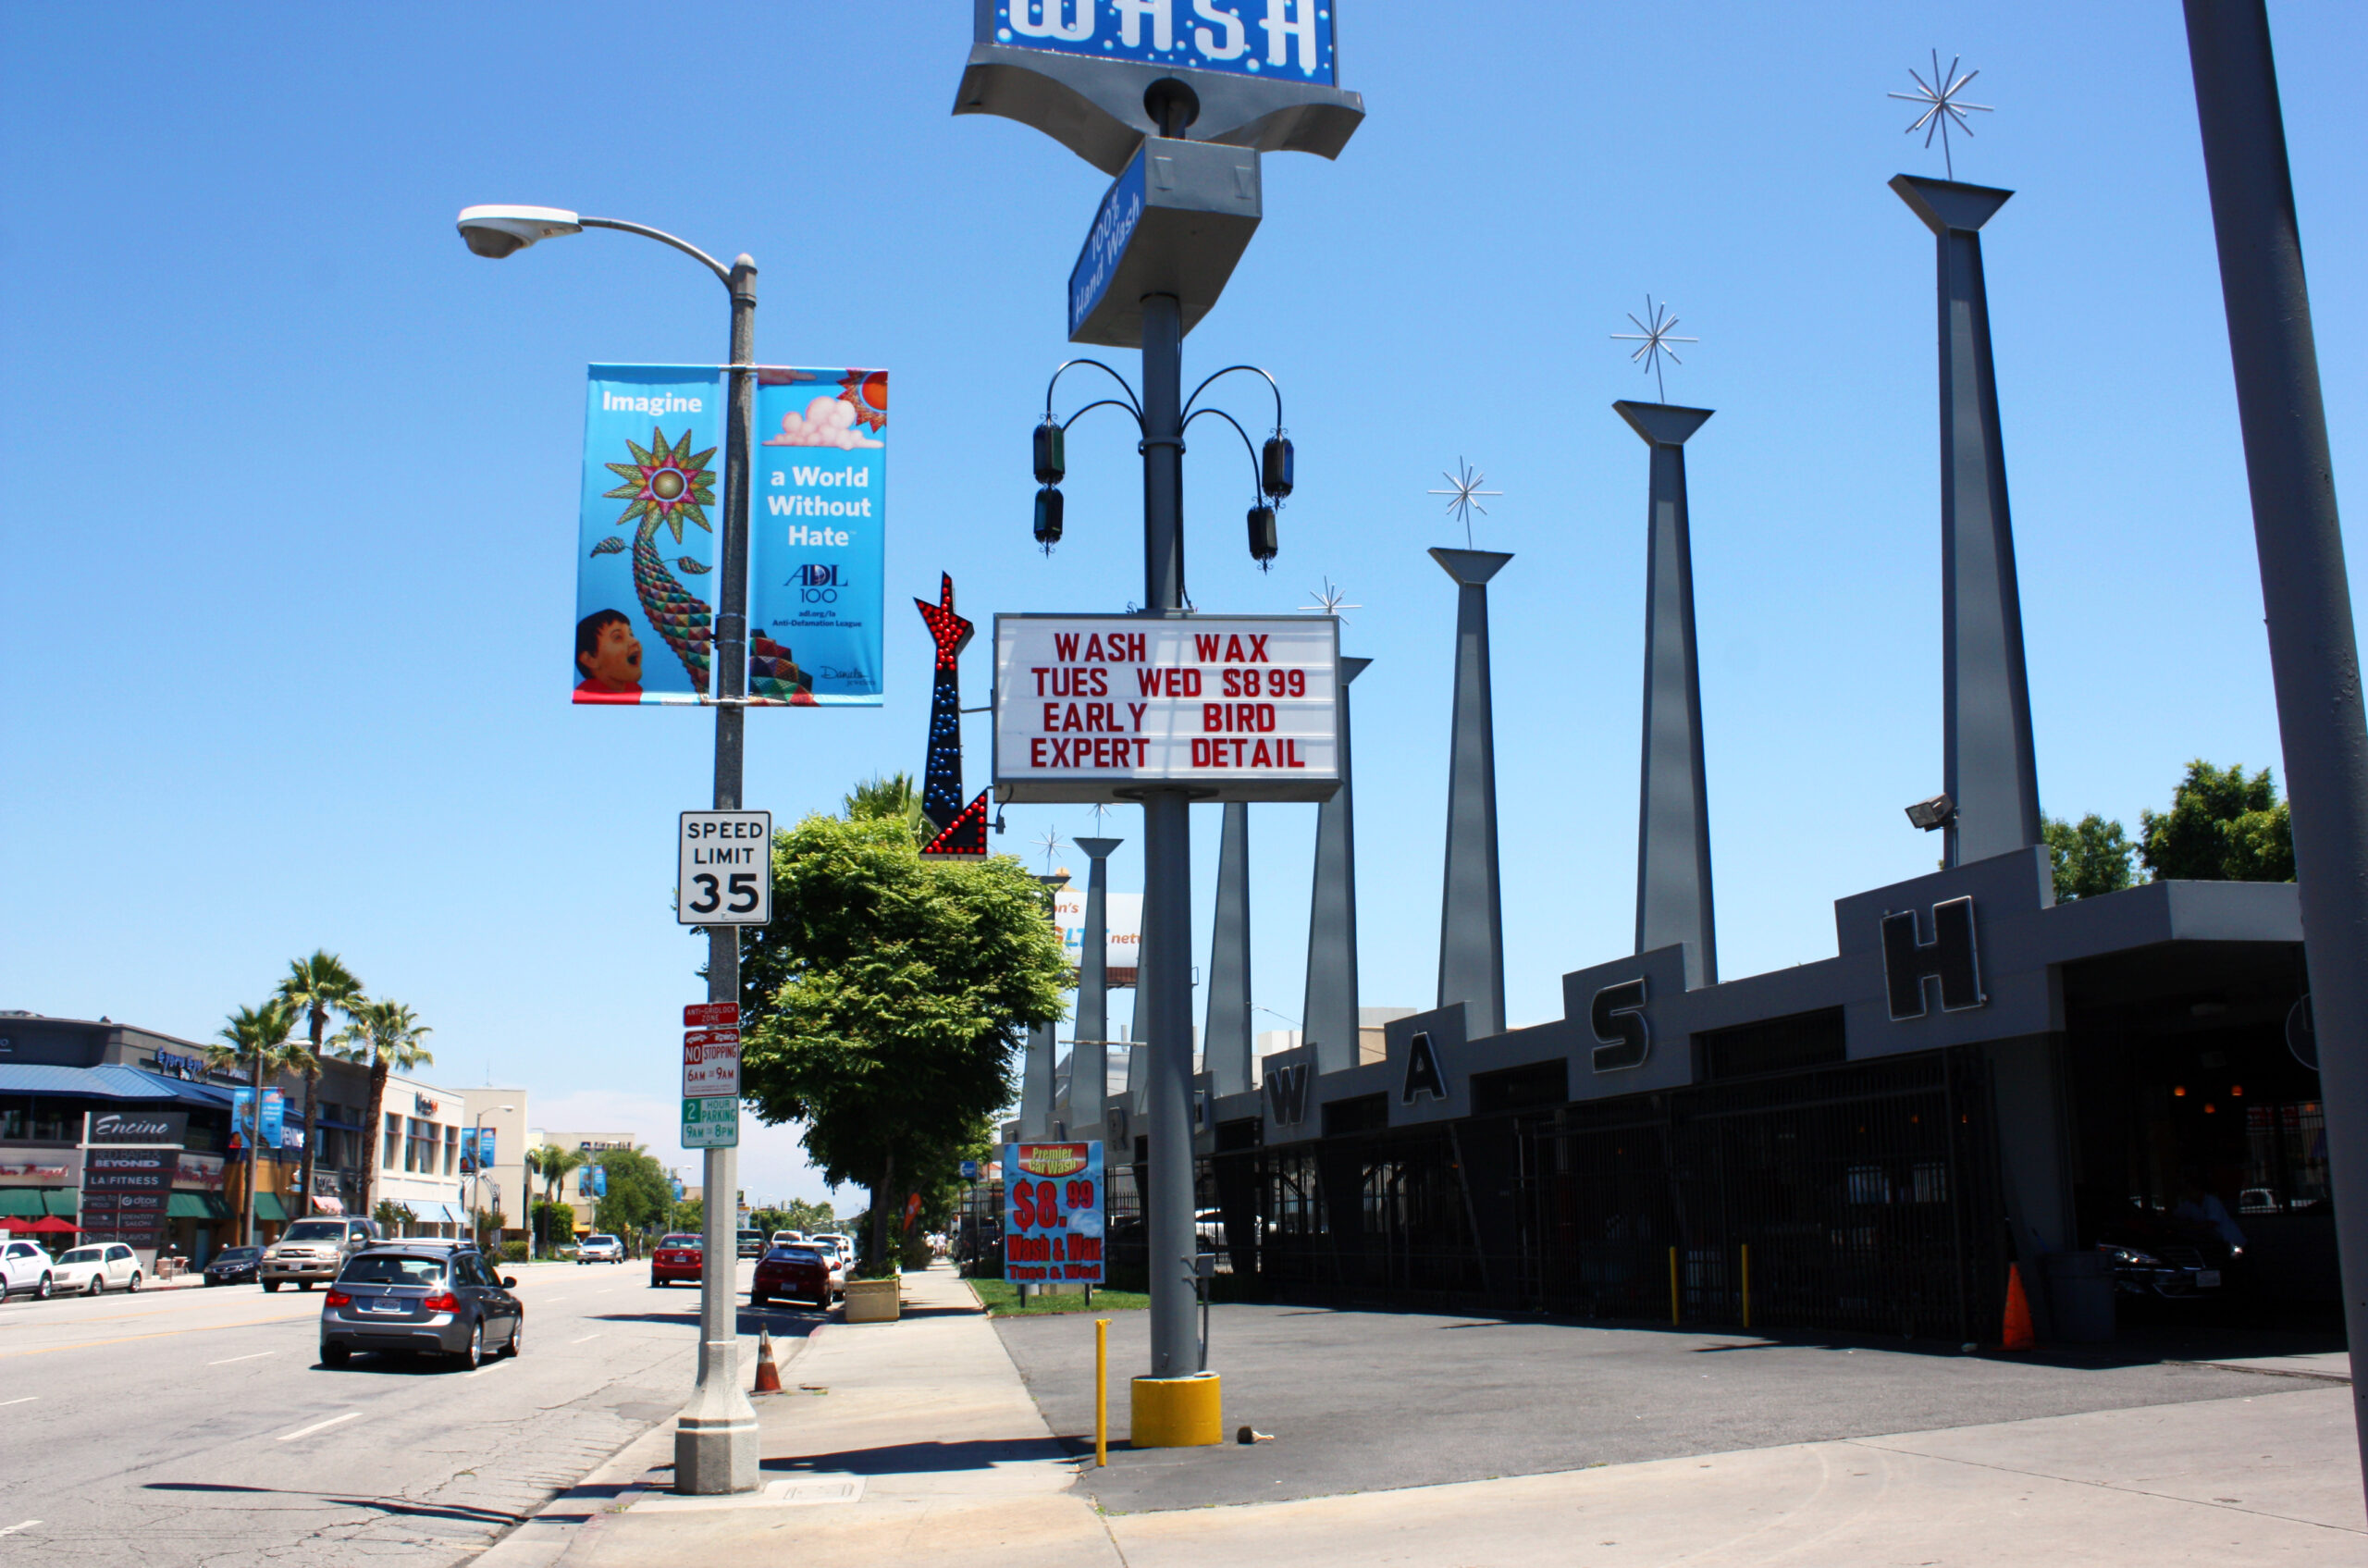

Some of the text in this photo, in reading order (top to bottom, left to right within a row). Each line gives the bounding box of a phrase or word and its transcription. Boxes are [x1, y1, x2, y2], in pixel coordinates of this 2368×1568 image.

[1092, 188, 1120, 261] 100%
[1076, 192, 1140, 322] Hand Wash
[603, 390, 702, 416] Imagine
[771, 466, 869, 487] a World
[768, 495, 871, 517] Without
[788, 525, 849, 546] Hate
[783, 563, 848, 586] ADL
[801, 588, 837, 603] 100
[835, 620, 862, 628] League
[1054, 633, 1269, 662] WASH WAX
[1031, 668, 1107, 697] TUES
[1137, 668, 1202, 697] WED
[1043, 703, 1276, 732] EARLY BIRD
[1030, 738, 1305, 768] EXPERT DETAIL
[688, 822, 763, 838] SPEED
[695, 848, 754, 864] LIMIT
[689, 873, 758, 913] 35
[687, 1006, 735, 1015] ANTI-GRIDLOCK
[685, 1045, 736, 1062] NO STOPPING
[688, 1069, 706, 1081] 6AM
[717, 1067, 734, 1080] 9AM
[688, 1100, 730, 1120] 2 HOUR
[702, 1109, 736, 1123] PARKING
[96, 1115, 168, 1134] Encino
[687, 1125, 703, 1138] 9AM
[715, 1124, 734, 1137] 8PM
[1032, 1147, 1073, 1159] Premier
[1029, 1157, 1077, 1174] Car Wash
[91, 1177, 159, 1185] LA FITNESS
[1006, 1233, 1103, 1262] Wash & Wax
[1007, 1264, 1101, 1279] Tues & Wed
